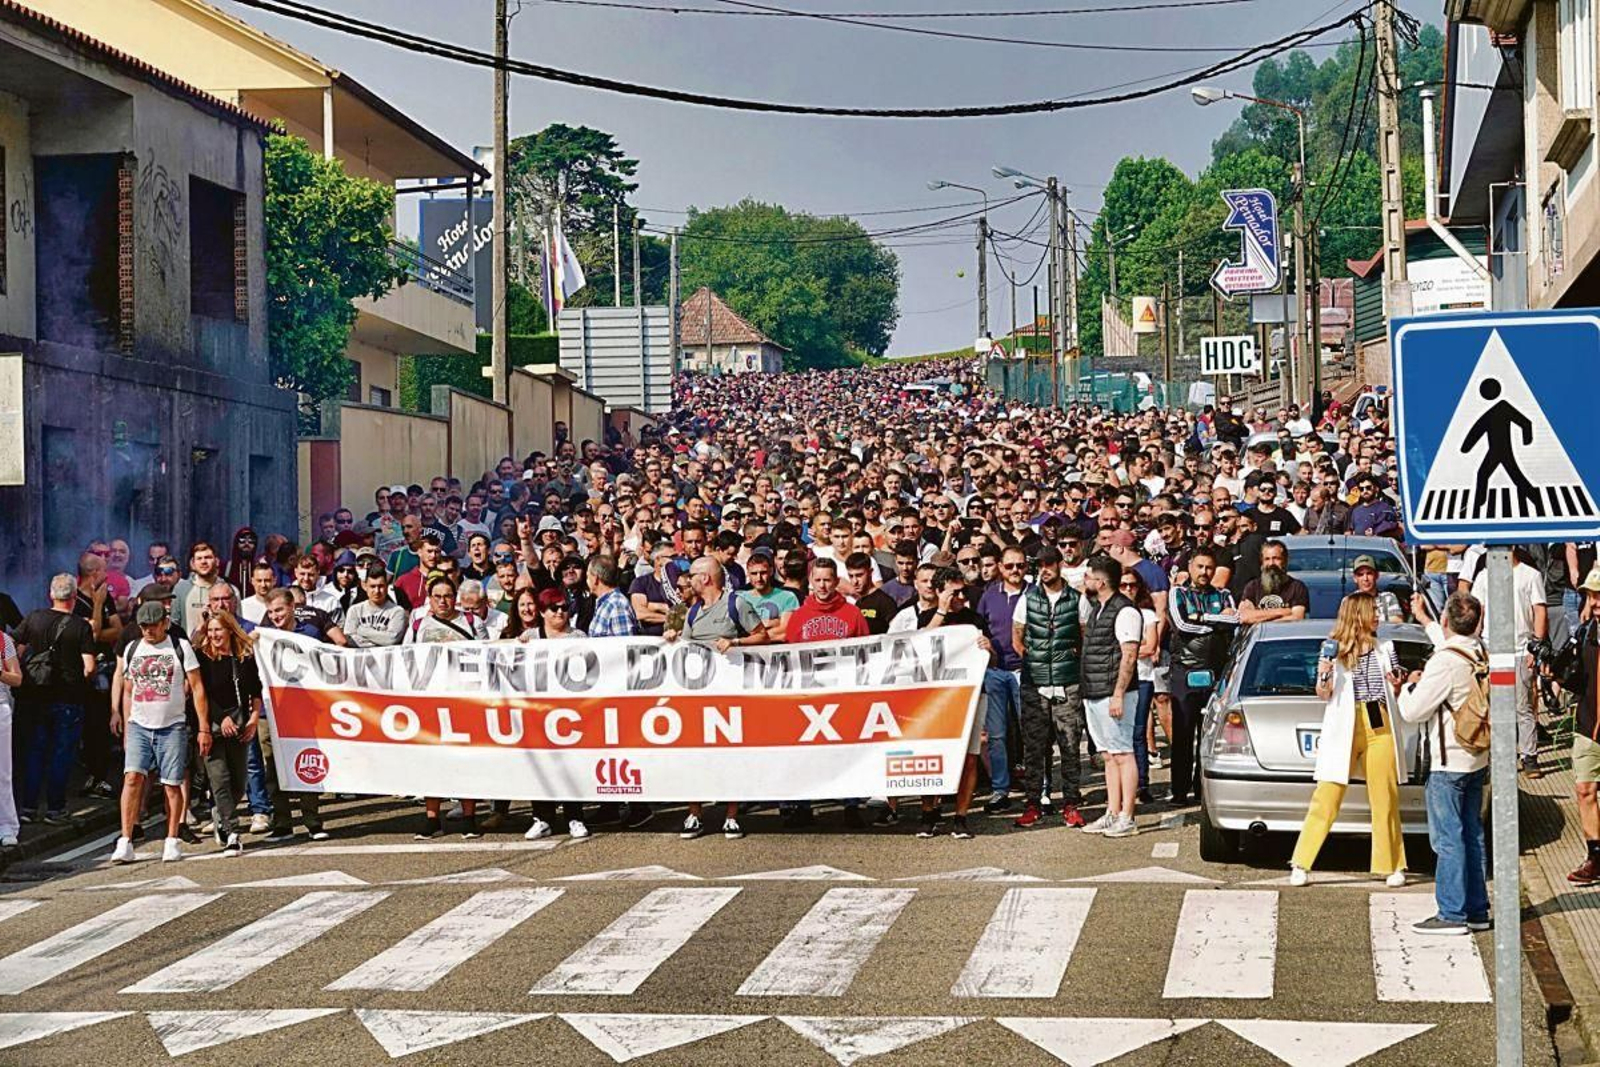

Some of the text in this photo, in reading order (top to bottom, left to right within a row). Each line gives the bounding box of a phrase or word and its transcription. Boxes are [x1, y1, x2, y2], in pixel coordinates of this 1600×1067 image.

[1205, 340, 1252, 370] HDC
[270, 634, 968, 693] CONVENIO DO METAL
[329, 697, 903, 746] SOLUCIÓN XA
[300, 754, 325, 769] UGT
[596, 758, 641, 785] CIG
[887, 756, 942, 775] CCOO
[886, 777, 943, 789] industria
